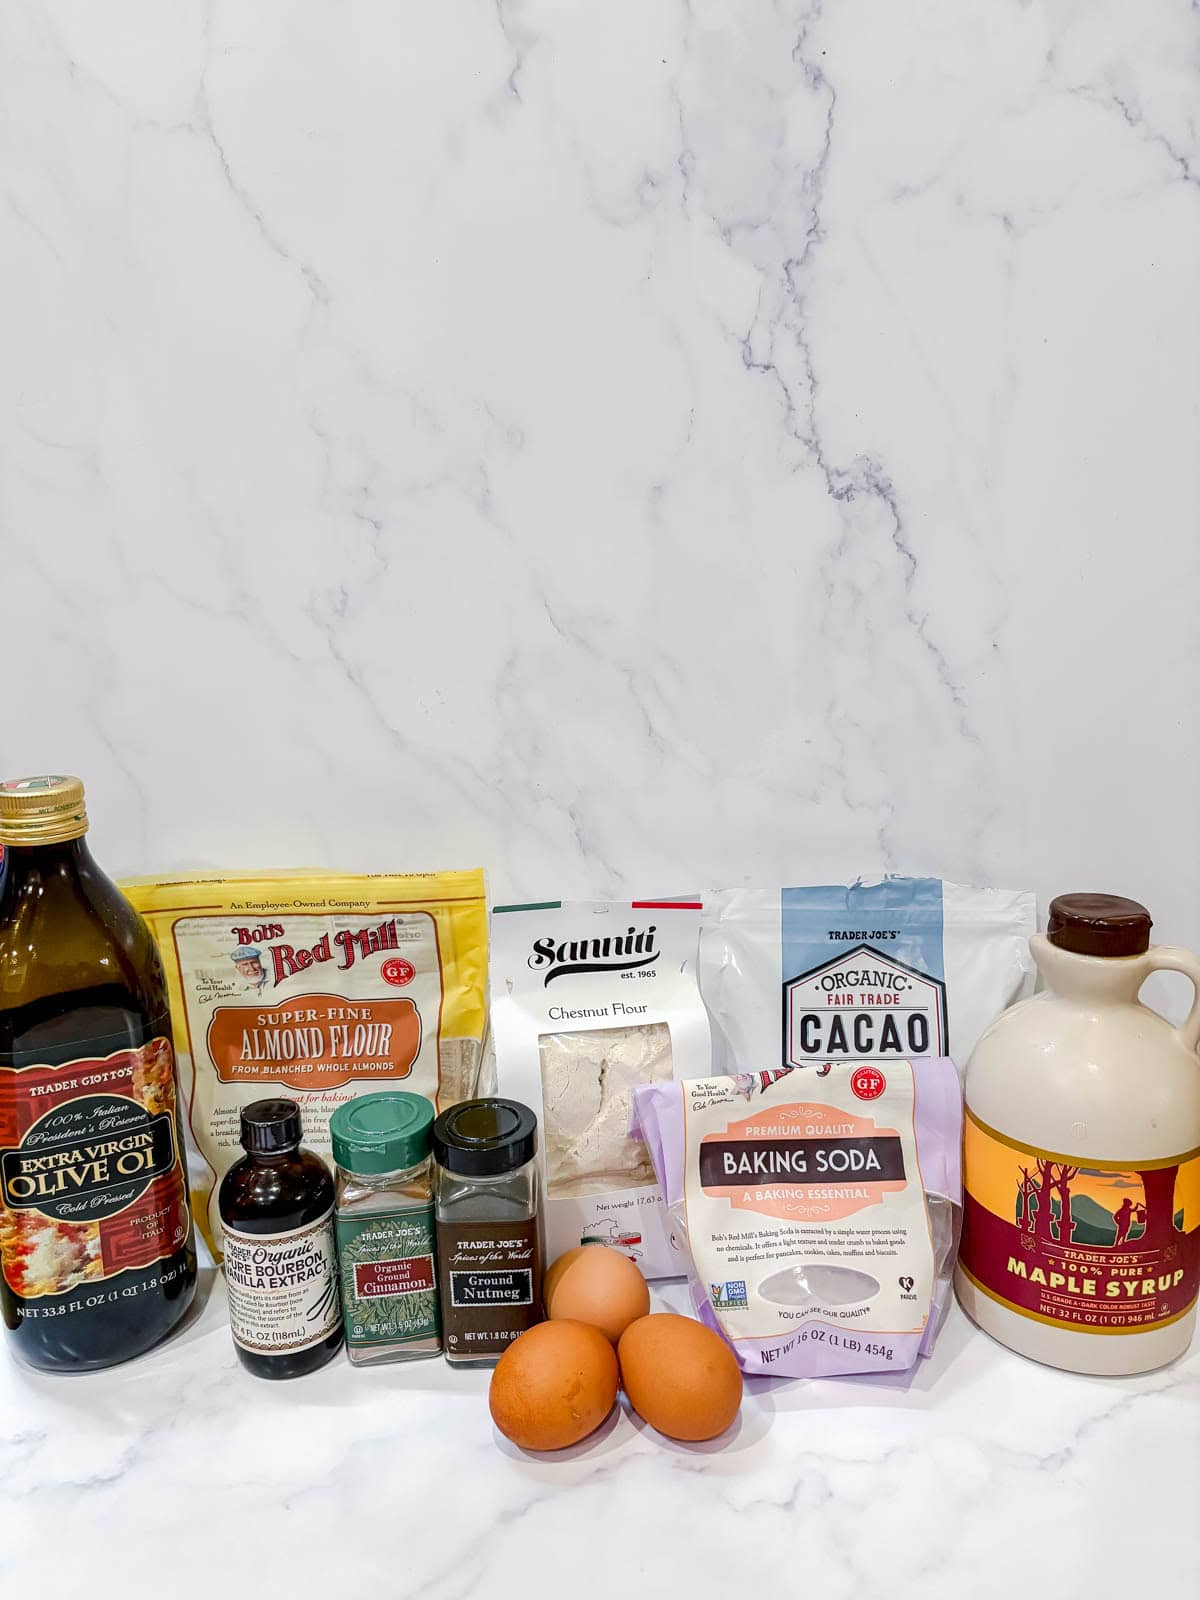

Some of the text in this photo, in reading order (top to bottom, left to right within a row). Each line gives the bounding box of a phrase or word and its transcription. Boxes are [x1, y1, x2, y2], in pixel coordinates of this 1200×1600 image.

[230, 899, 371, 911] An Employee-Owned Company
[231, 923, 285, 946] Bob's
[828, 930, 897, 940] TRADER JOE'S
[268, 919, 400, 988] Red Mill
[527, 926, 657, 970] Sanniti
[387, 968, 410, 977] GF
[821, 970, 908, 992] ORGANIC
[827, 994, 900, 1005] FAIR TRADE
[257, 1008, 373, 1026] SUPER-FINE
[549, 1003, 648, 1020] Chestnut Flour
[800, 1014, 929, 1053] CACAO
[240, 1023, 394, 1061] ALMOND FLOUR
[232, 1062, 394, 1074] FROM BLANCHED WHOLE ALMONDS
[29, 1067, 134, 1097] TRADER GIOTTO'S
[857, 1079, 880, 1090] GF
[306, 1093, 320, 1104] for
[44, 1104, 130, 1129] 100% Italian
[26, 1114, 149, 1146] President's Reserve
[745, 1123, 855, 1137] PREMIUM QUALITY
[20, 1131, 155, 1174] EXTRA VIRGIN
[723, 1148, 881, 1175] BAKING SODA
[7, 1158, 110, 1198] OLIVE
[56, 1189, 136, 1216] Cold Pressed
[742, 1187, 869, 1202] A BAKING ESSENTIAL
[596, 1204, 610, 1212] Net
[611, 1201, 634, 1210] weight
[130, 1206, 171, 1226] PRODUCT
[141, 1226, 165, 1241] ITALY
[146, 1221, 159, 1230] OF
[361, 1227, 420, 1241] TRADER JOE'S
[758, 1230, 779, 1240] Baking
[457, 1239, 523, 1249] TRADER JOE'S
[252, 1239, 314, 1266] Organic
[1064, 1250, 1139, 1264] TRADER JOE'S
[255, 1250, 322, 1277] BOURBON
[374, 1261, 412, 1274] Organic
[1060, 1262, 1143, 1277] 100% PURE
[227, 1258, 328, 1289] VANILLA EXTRACT
[377, 1271, 410, 1282] Ground
[469, 1275, 513, 1286] Ground
[1007, 1256, 1185, 1297] MAPLE SYRUP
[16, 1269, 177, 1318] NET 33.8 FL OZ (1 QT 1.8 OZ)
[364, 1278, 426, 1294] Cinnamon
[463, 1287, 521, 1300] Nutmeg
[778, 1311, 794, 1319] YOU
[795, 1310, 809, 1319] CAN
[823, 1309, 838, 1318] OUR
[839, 1308, 867, 1319] QUALITY
[1040, 1304, 1056, 1315] NET
[1059, 1309, 1070, 1318] 32
[1072, 1312, 1082, 1320] FL
[1085, 1314, 1097, 1323] OZ
[1100, 1315, 1108, 1325] (1
[1110, 1316, 1126, 1325] QT)
[1128, 1314, 1142, 1323] 946
[246, 1326, 306, 1342] FL OZ (118mL)
[464, 1331, 509, 1340] NET WT. 1.8 OZ
[761, 1329, 894, 1364] NET WT 16 OZ (1 LB) 454g
